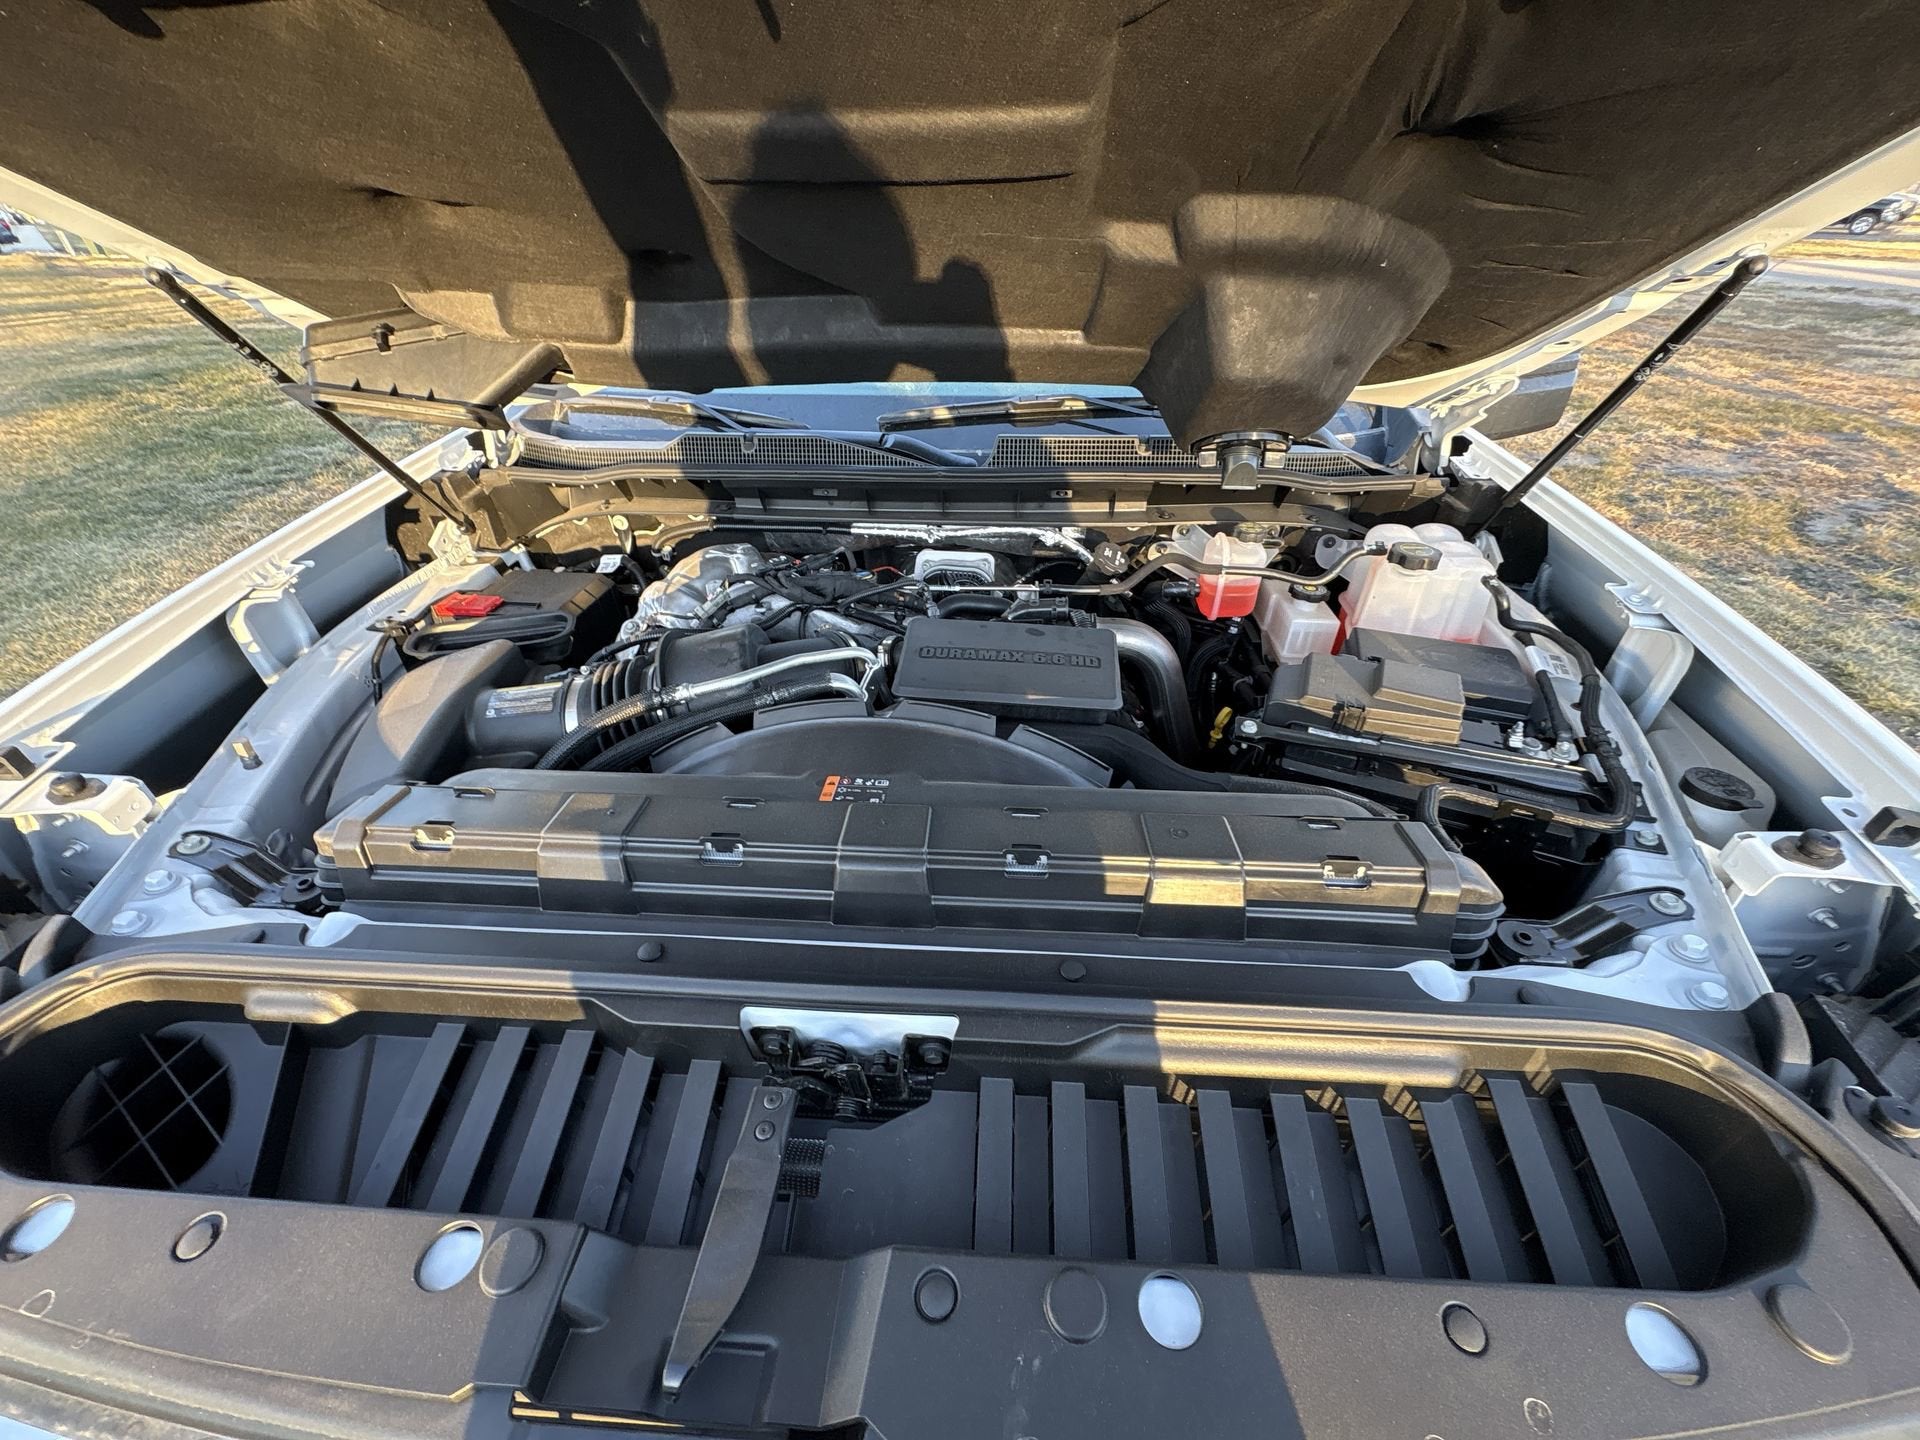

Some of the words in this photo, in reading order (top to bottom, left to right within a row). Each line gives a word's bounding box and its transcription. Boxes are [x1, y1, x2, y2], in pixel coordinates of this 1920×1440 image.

[920, 647, 1024, 662] DURAMAX
[1032, 651, 1066, 665] 6.6
[1070, 655, 1101, 668] HD
